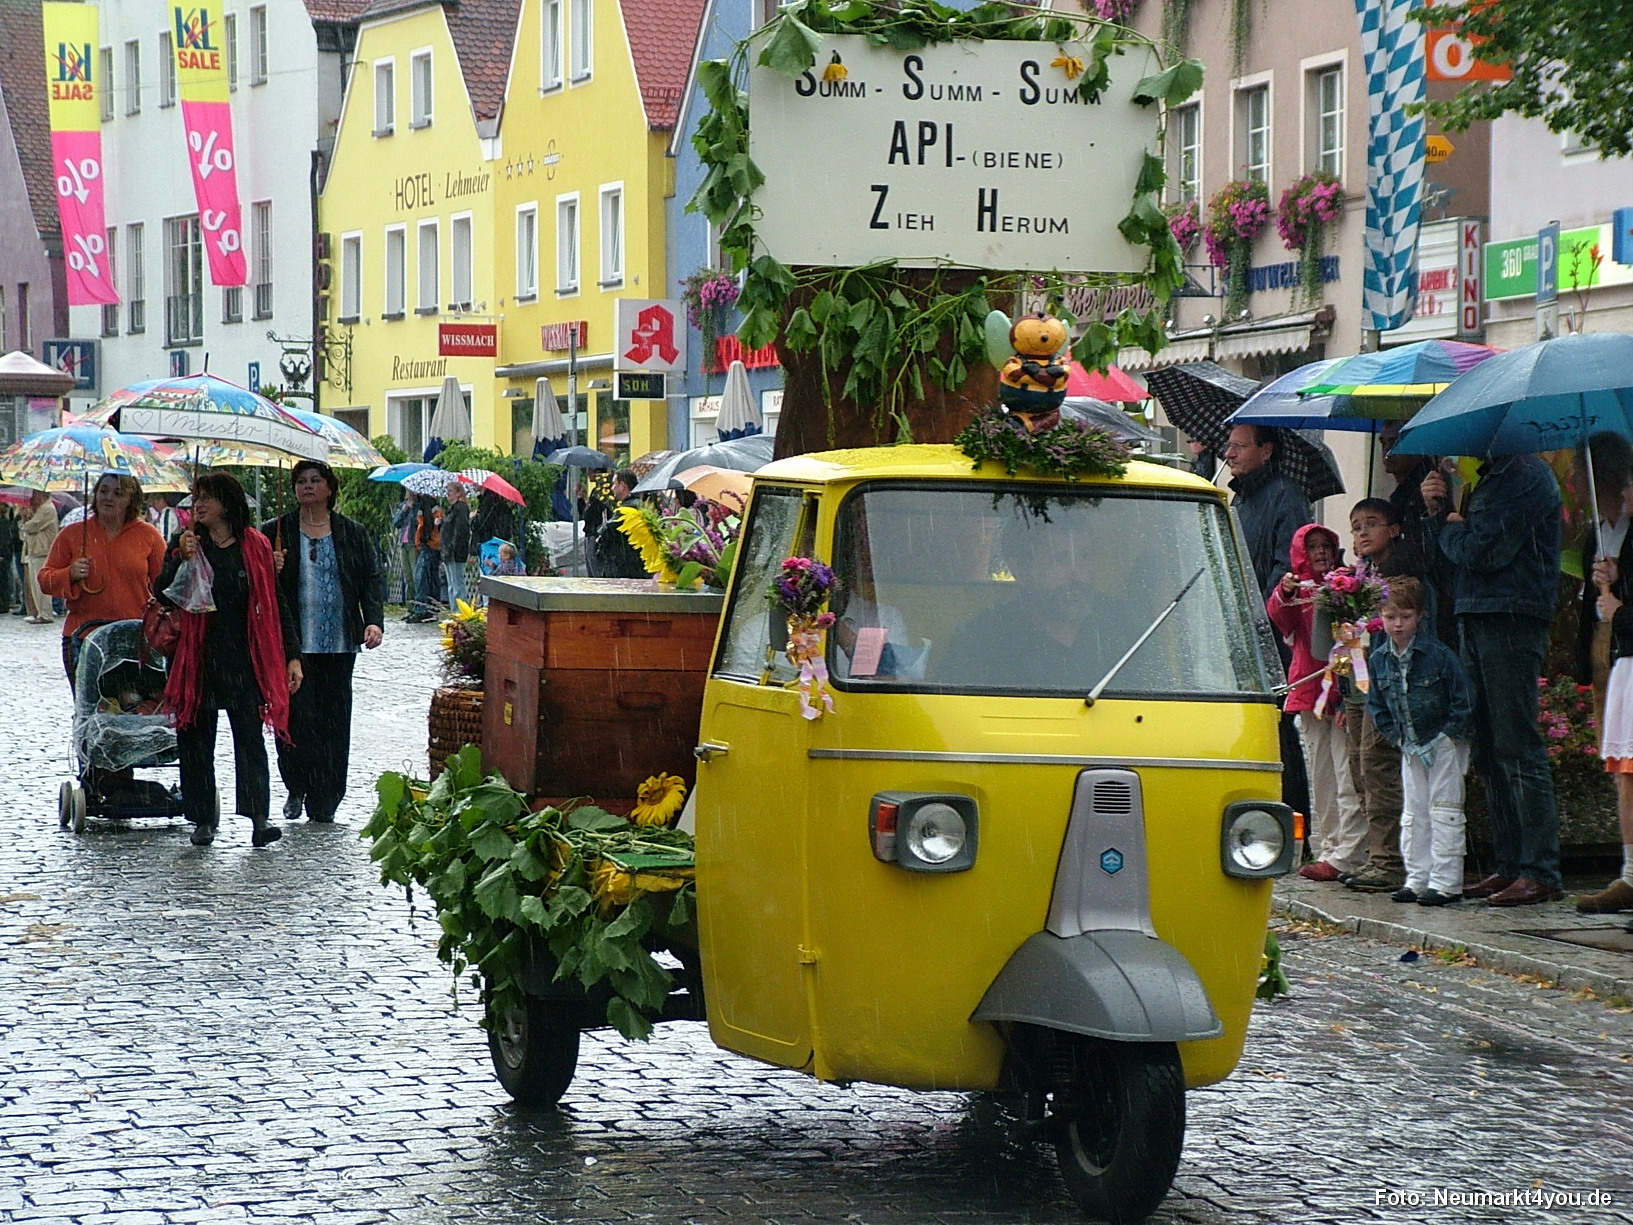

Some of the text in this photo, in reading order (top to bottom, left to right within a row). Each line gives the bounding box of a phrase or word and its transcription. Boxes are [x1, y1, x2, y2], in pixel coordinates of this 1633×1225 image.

[178, 51, 221, 70] SALE
[395, 168, 490, 212] HOTEL Lehmeier
[1464, 224, 1478, 329] KINO
[1502, 248, 1522, 279] 360
[1541, 236, 1554, 293] P
[442, 334, 494, 347] WISSMACH
[392, 356, 447, 381] Restaurant
